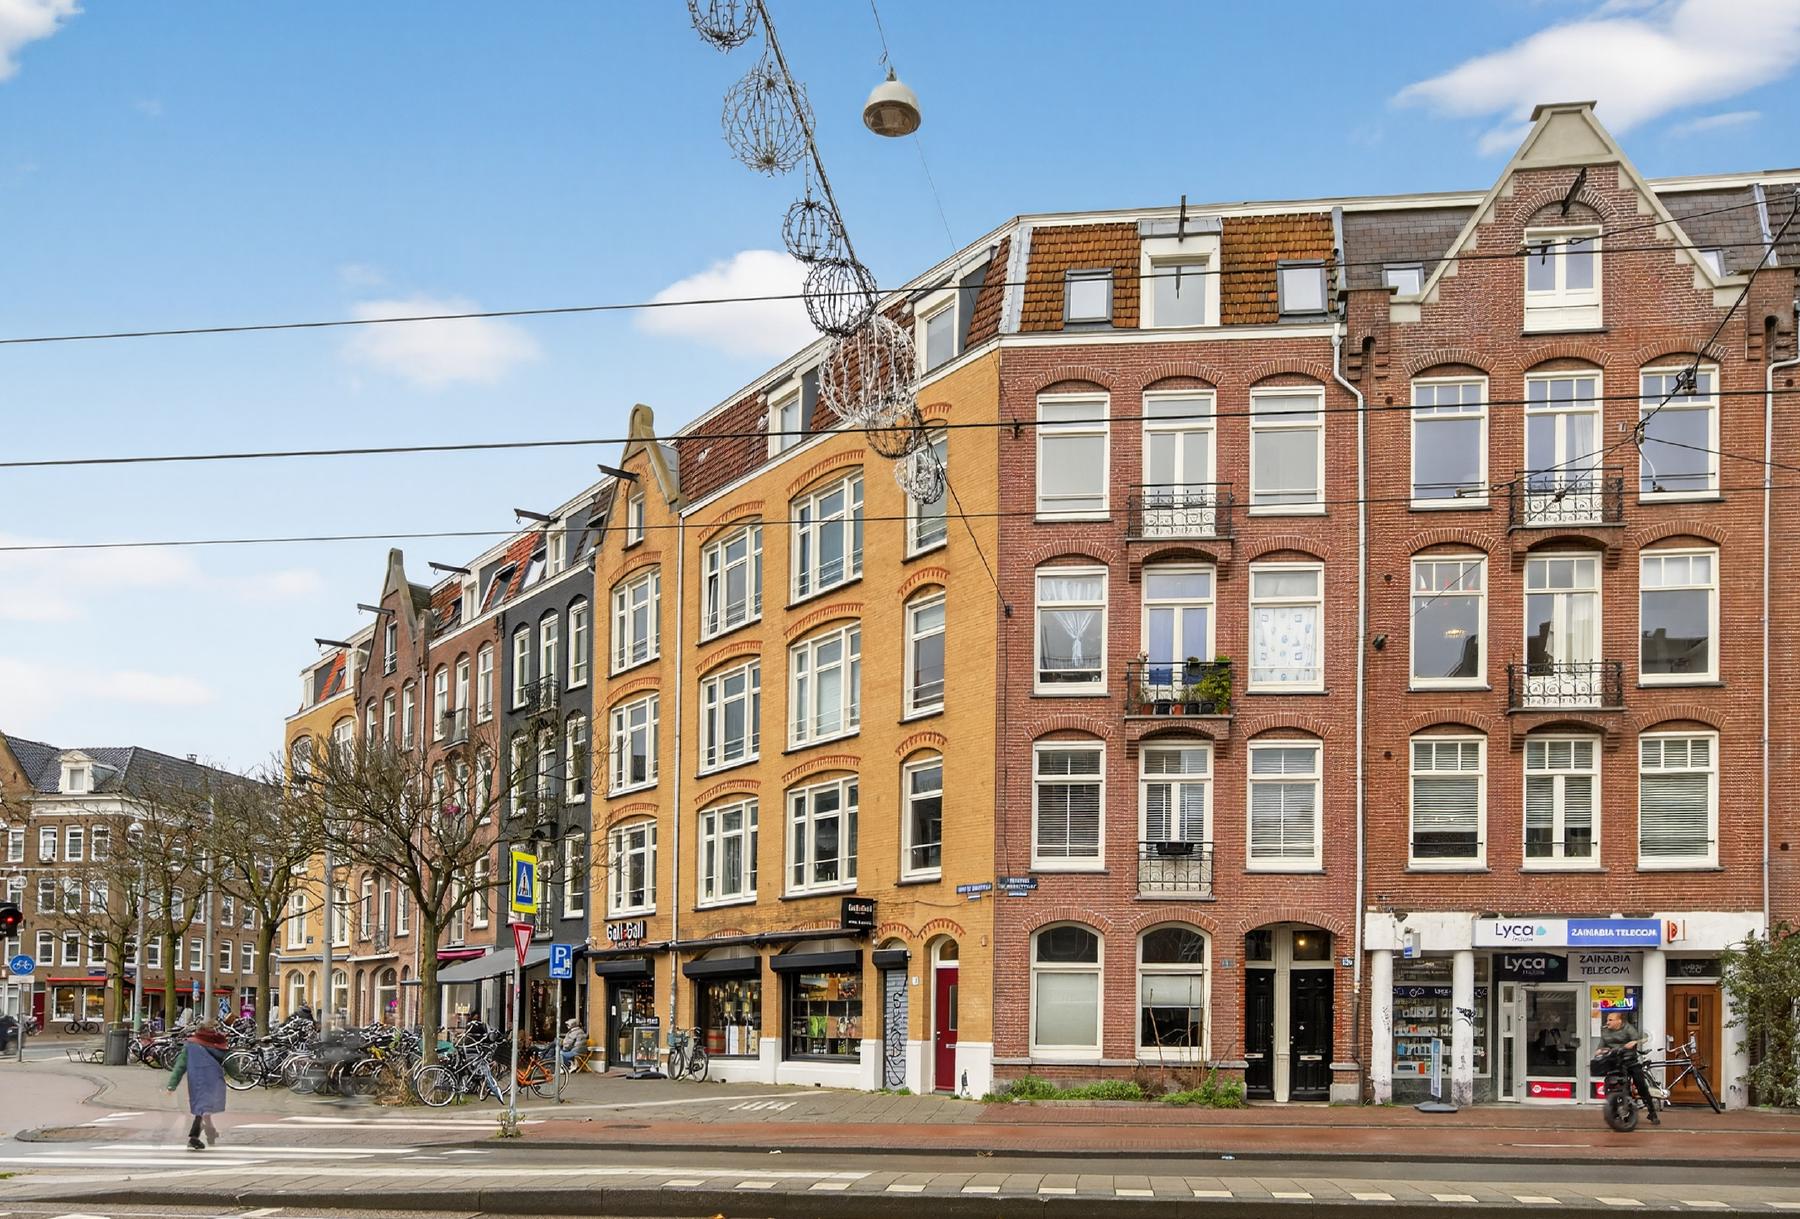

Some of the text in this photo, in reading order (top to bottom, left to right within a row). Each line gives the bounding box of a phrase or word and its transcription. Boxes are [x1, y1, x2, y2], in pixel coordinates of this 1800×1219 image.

[1495, 922, 1534, 938] Lyca
[1571, 928, 1657, 937] ZAINABIA TELECOM
[555, 946, 567, 964] P
[1579, 955, 1631, 964] ZAINABIA
[1504, 955, 1546, 972] Lyca
[1580, 966, 1630, 975] TELECOM
